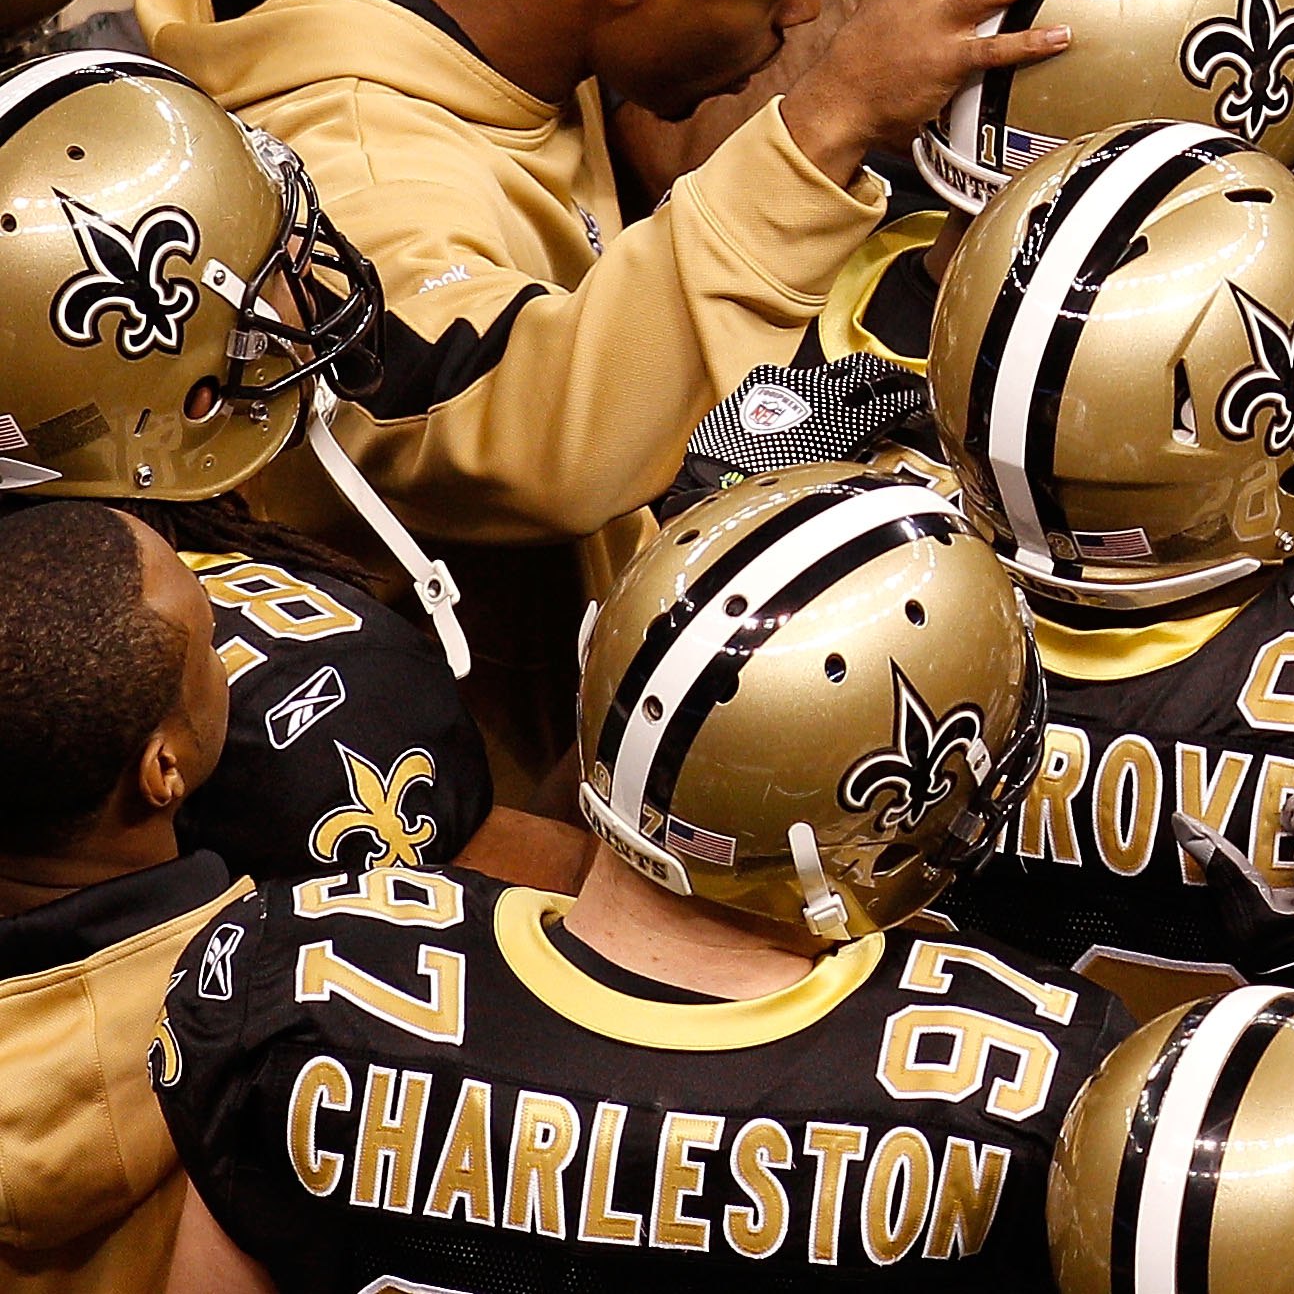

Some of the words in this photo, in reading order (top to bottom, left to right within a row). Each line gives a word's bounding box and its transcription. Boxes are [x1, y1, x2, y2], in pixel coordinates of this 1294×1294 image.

[981, 124, 997, 167] 1
[640, 803, 665, 838] 7
[286, 1055, 1011, 1266] CHARLESTON
